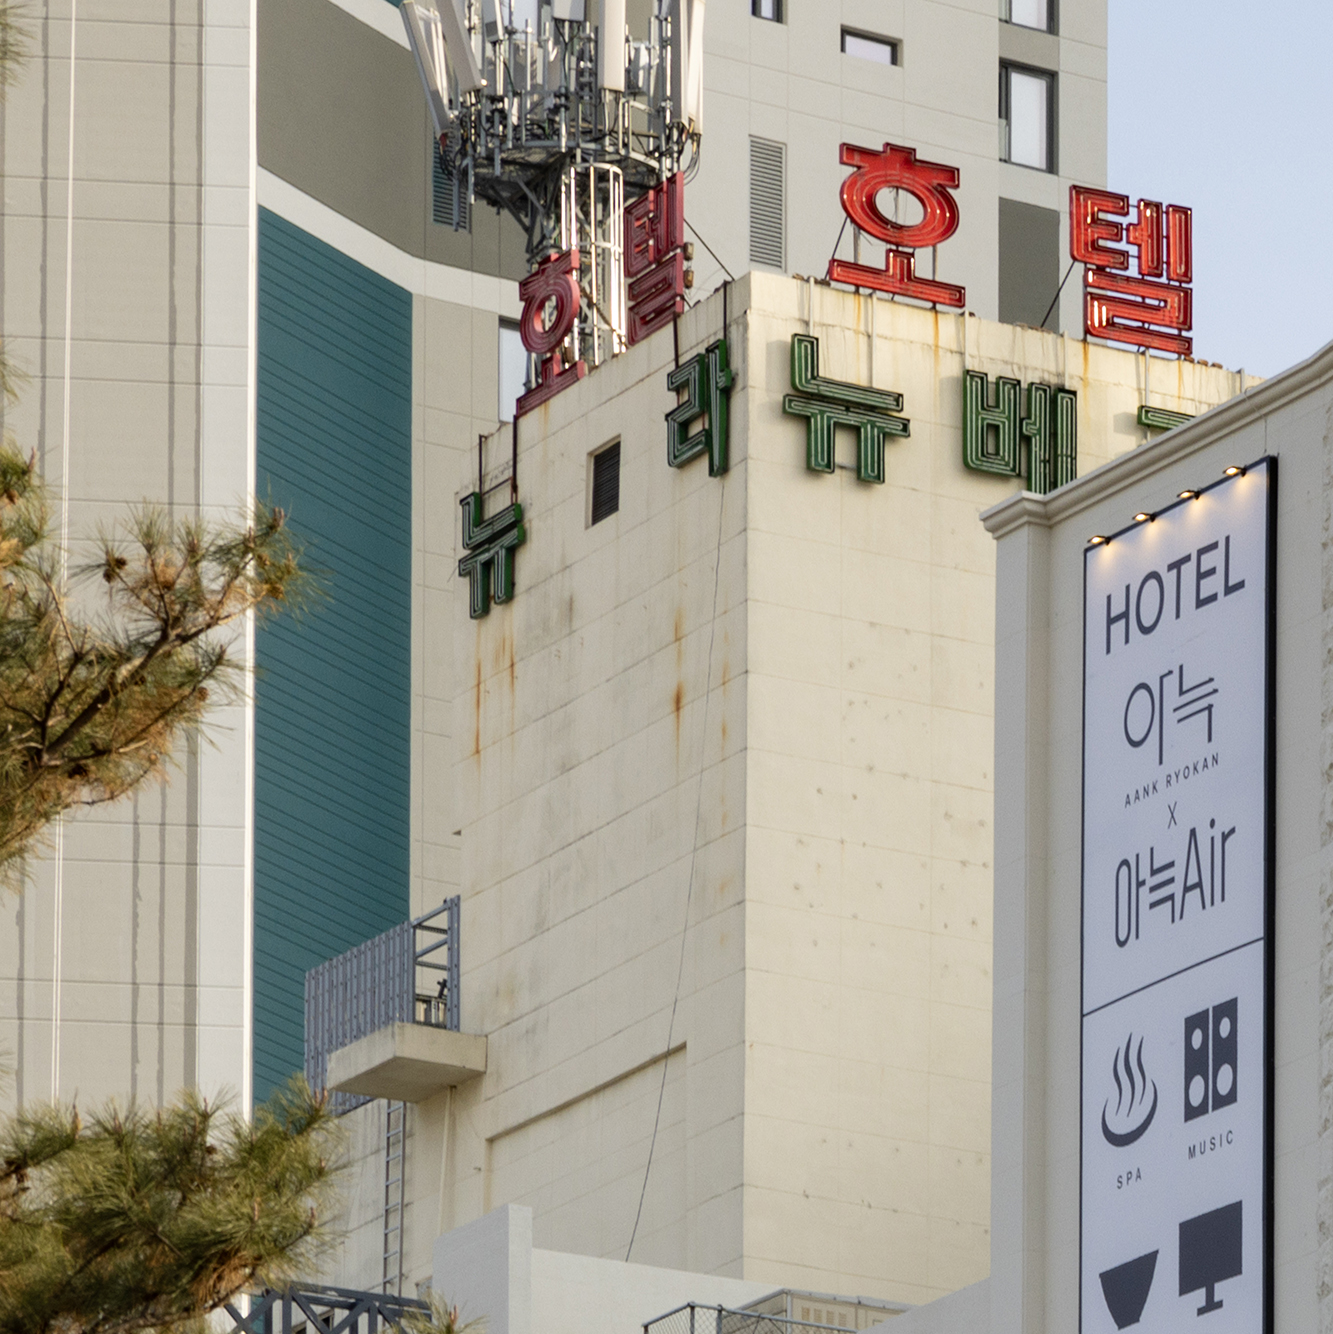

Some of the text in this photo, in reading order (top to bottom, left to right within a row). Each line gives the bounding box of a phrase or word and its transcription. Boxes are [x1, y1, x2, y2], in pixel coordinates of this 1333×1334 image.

[829, 142, 1193, 356] 호텔
[515, 171, 684, 418] 호텔
[1106, 535, 1245, 655] HOTEL
[1125, 753, 1219, 808] AANK RYOKAN
[1117, 1167, 1142, 1190] SPA
[1188, 1130, 1233, 1159] MUSIC
